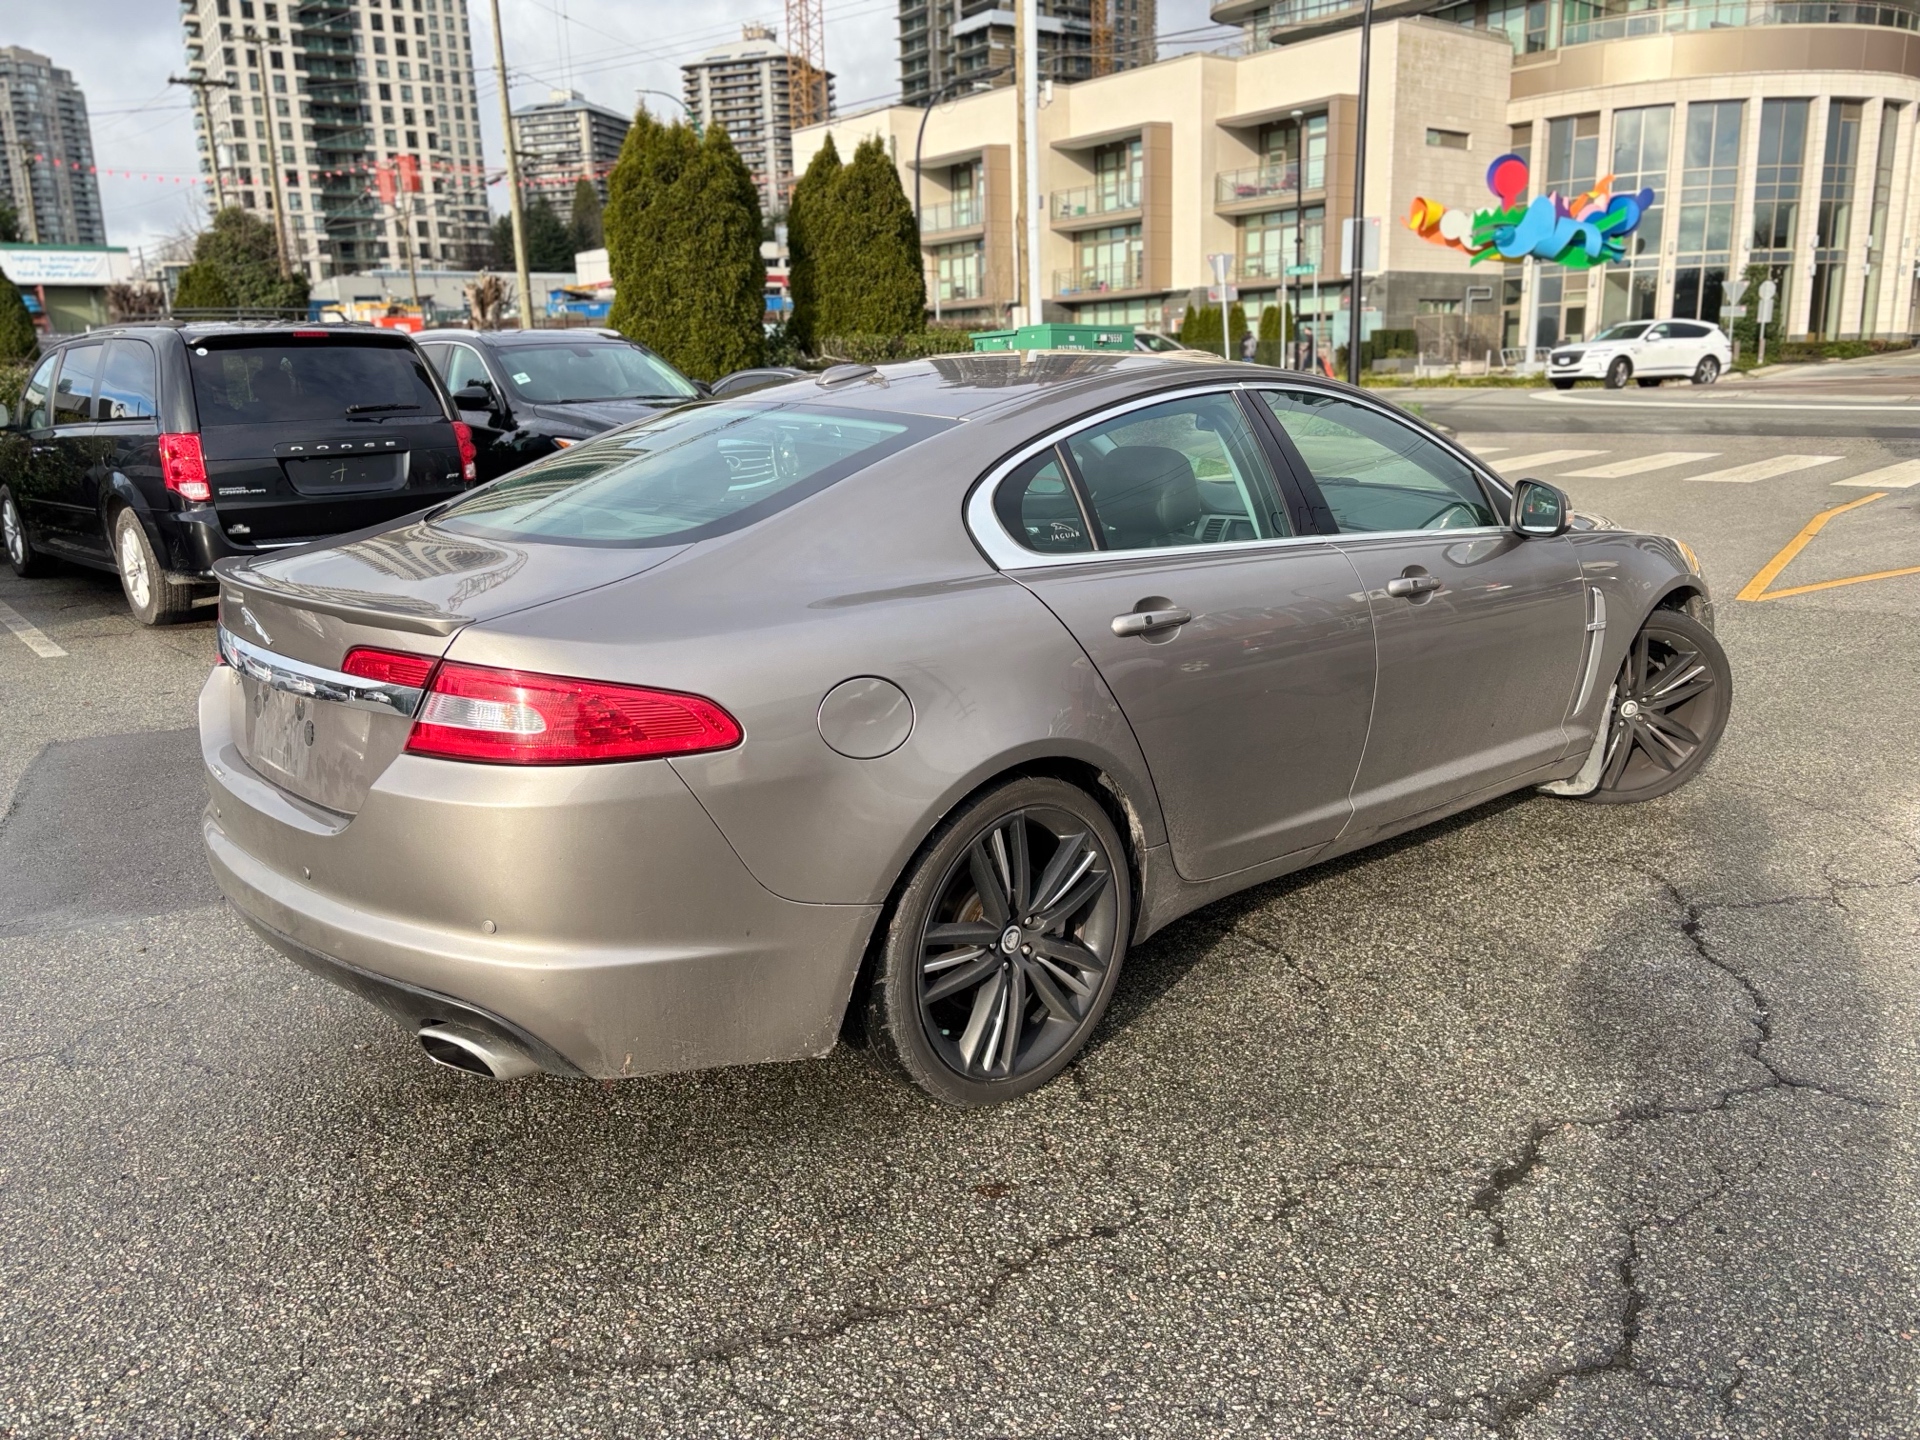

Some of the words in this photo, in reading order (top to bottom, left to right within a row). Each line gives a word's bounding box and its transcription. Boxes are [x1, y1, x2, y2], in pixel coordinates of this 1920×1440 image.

[290, 441, 396, 451] DODGE
[218, 488, 267, 496] CARAVAN
[1050, 531, 1081, 541] JAGUAR
